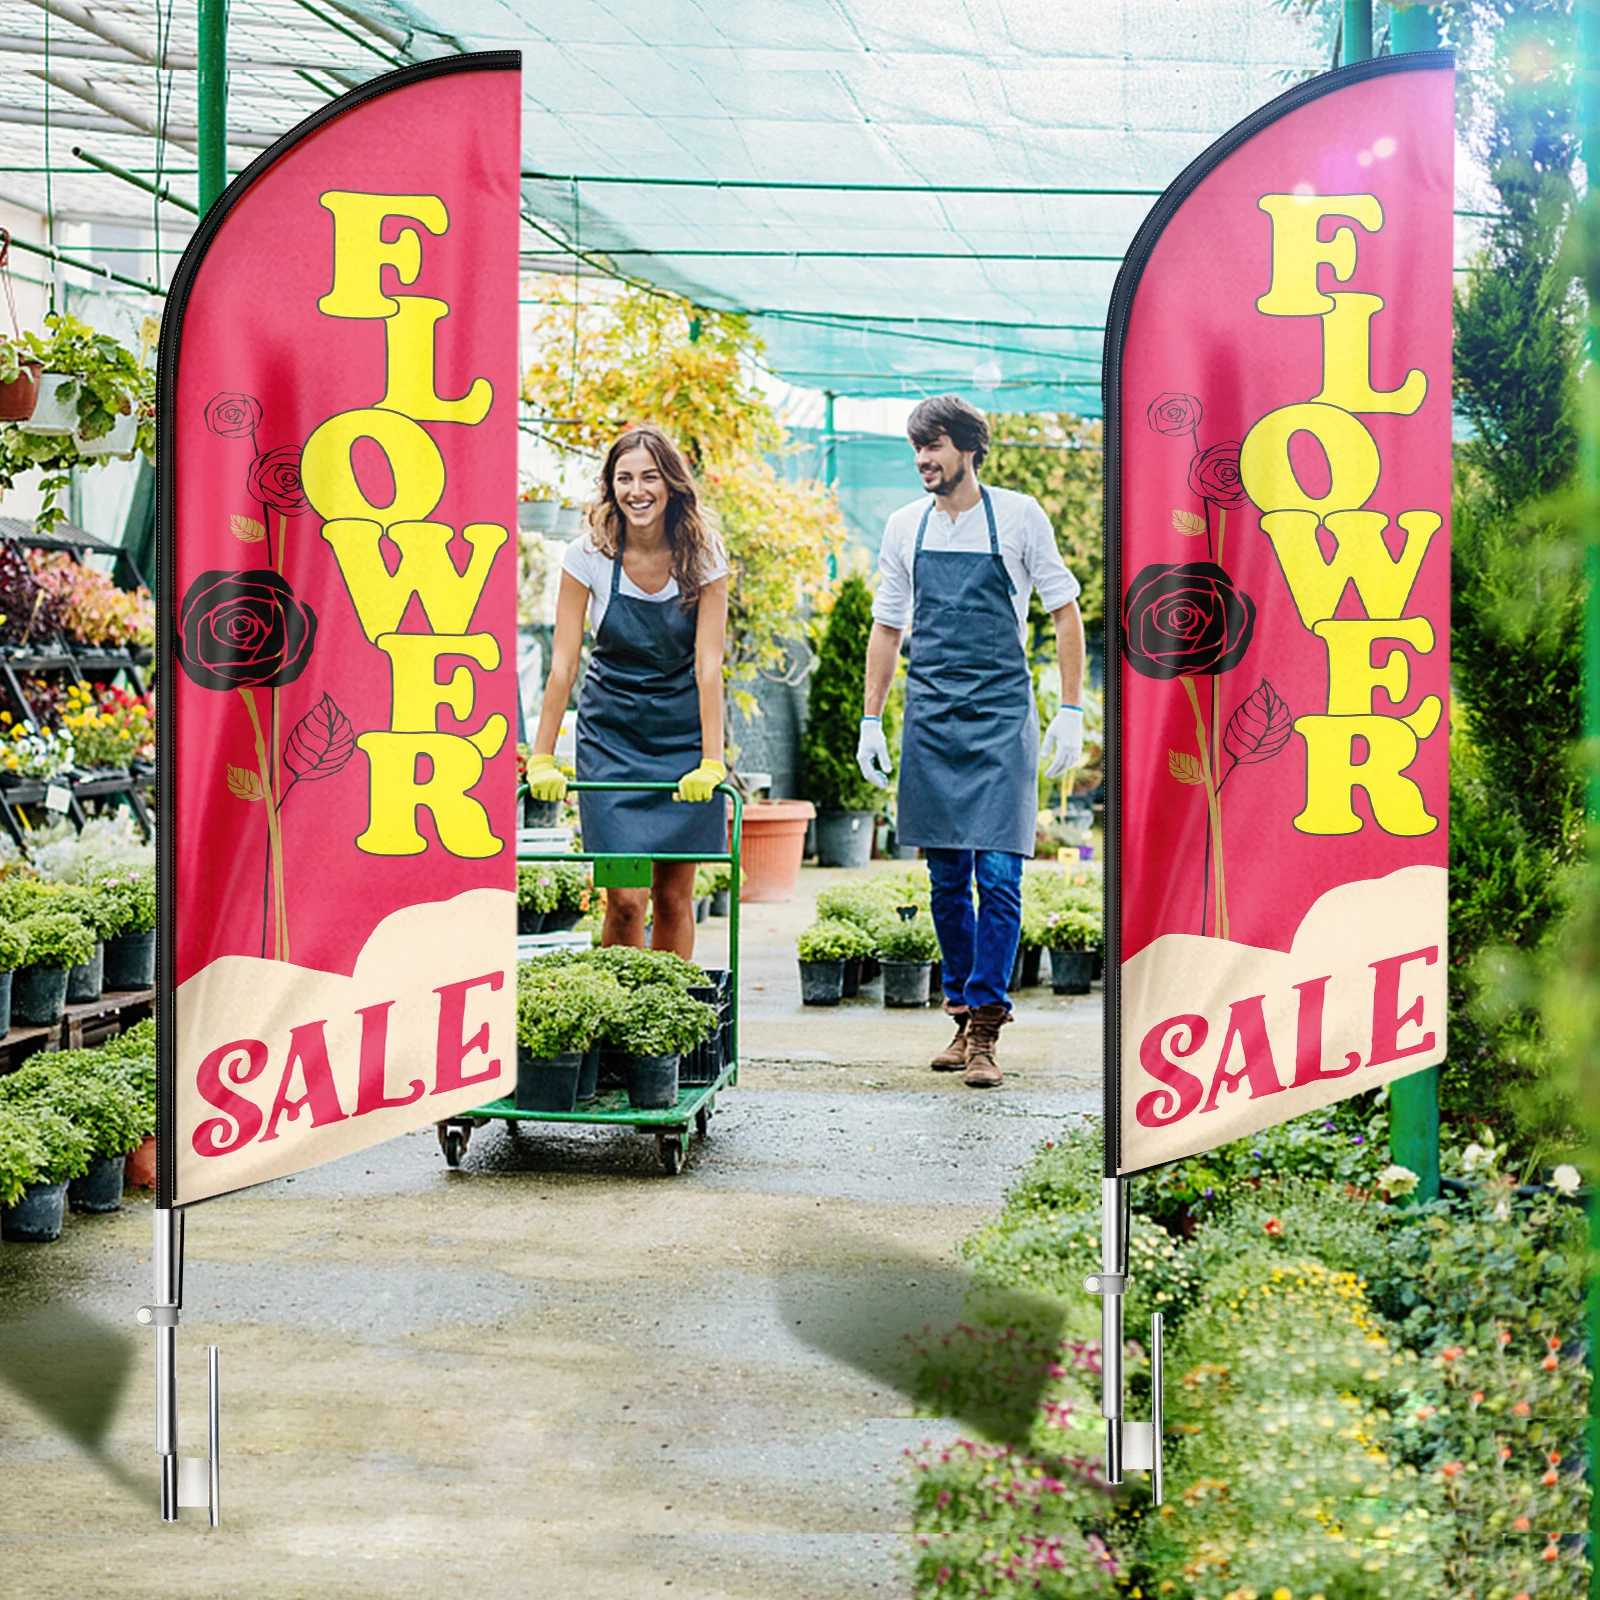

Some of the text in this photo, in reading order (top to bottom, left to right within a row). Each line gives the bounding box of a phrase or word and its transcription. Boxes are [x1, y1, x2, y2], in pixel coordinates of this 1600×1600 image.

[300, 190, 509, 860] FLOWER
[1239, 194, 1443, 837] FLOWER
[191, 970, 505, 1158] SALE
[1136, 945, 1439, 1128] SALE
